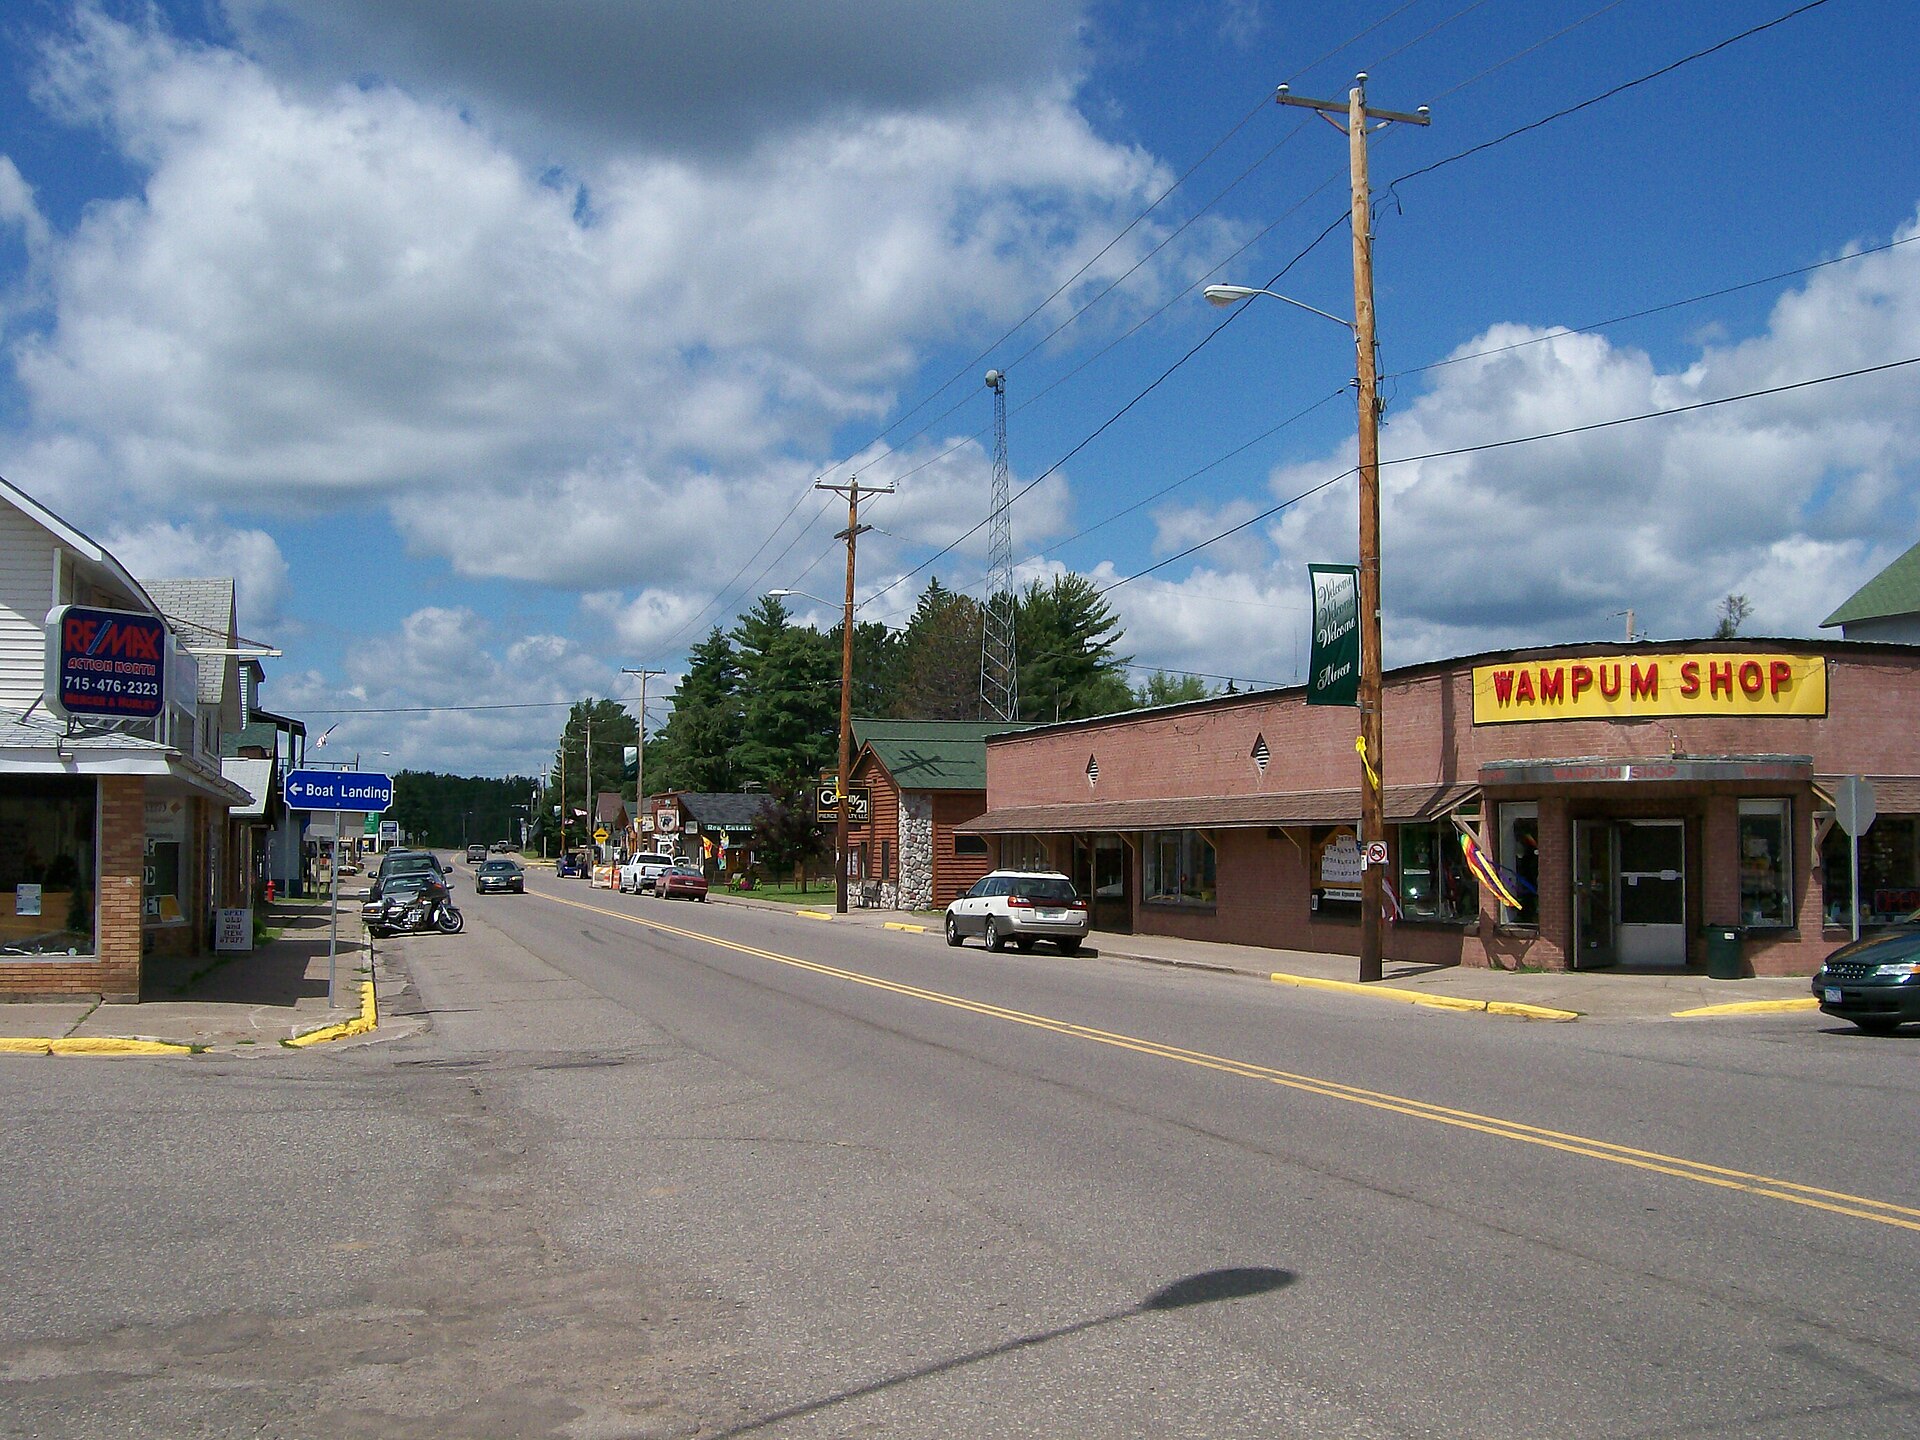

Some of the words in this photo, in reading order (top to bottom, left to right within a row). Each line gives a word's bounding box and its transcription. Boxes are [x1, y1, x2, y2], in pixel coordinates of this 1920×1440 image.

[1318, 576, 1352, 604] Welcome
[1318, 597, 1354, 625] Welcome
[65, 618, 160, 660] RE/MAX
[1317, 618, 1355, 649] Welcome
[67, 657, 113, 672] ACTION
[115, 661, 156, 676] NORTH
[1317, 662, 1351, 690] Mercer
[1493, 663, 1658, 702] WAMPUM
[1680, 660, 1792, 695] SHOP
[1552, 766, 1622, 780] WAMPUM
[1630, 765, 1678, 779] SHOP
[306, 783, 334, 797] Boat
[341, 785, 389, 802] Landing
[855, 800, 867, 813] 21
